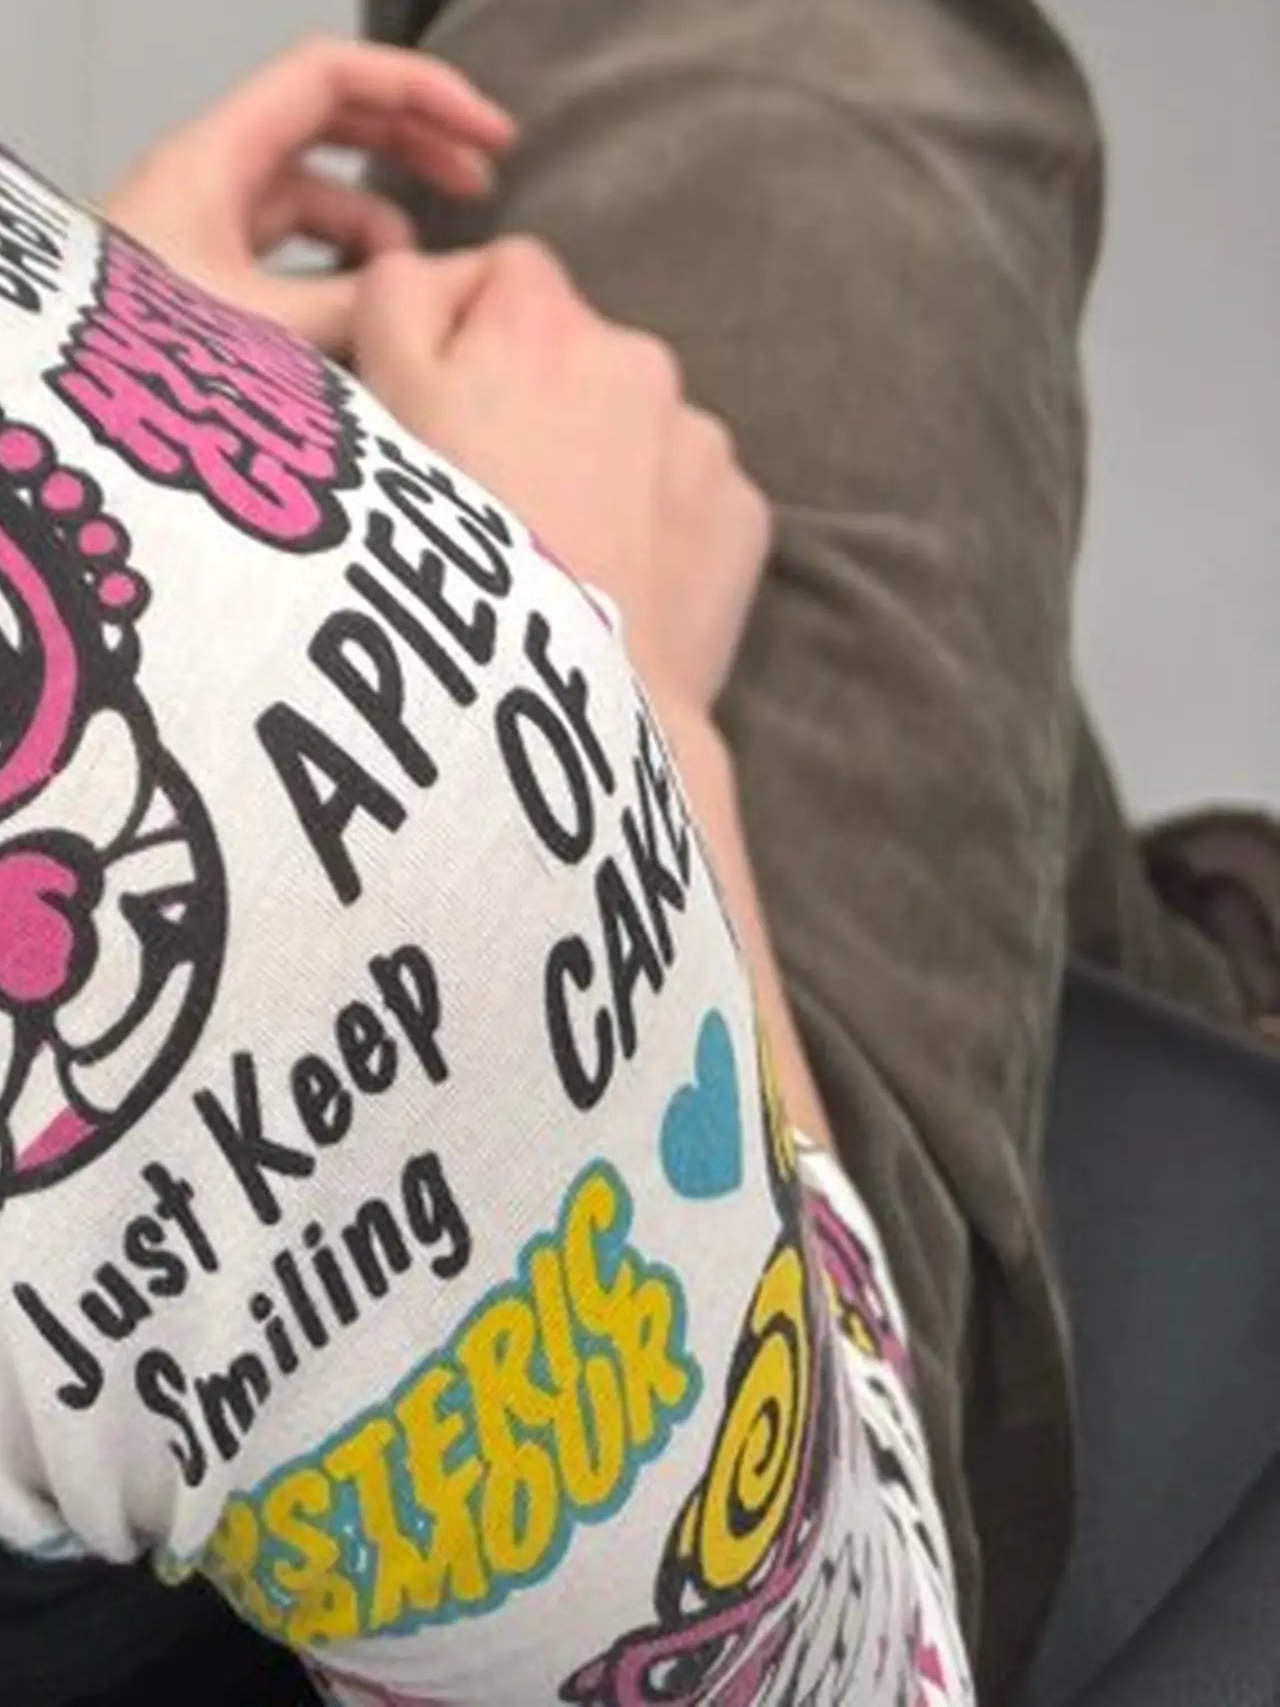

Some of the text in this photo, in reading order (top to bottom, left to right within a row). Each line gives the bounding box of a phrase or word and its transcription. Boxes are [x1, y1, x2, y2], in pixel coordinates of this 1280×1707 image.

[493, 609, 617, 866] OF
[543, 695, 692, 1112] CAKE
[11, 941, 453, 1411] Just Keep
[132, 1149, 475, 1490] Smiling
